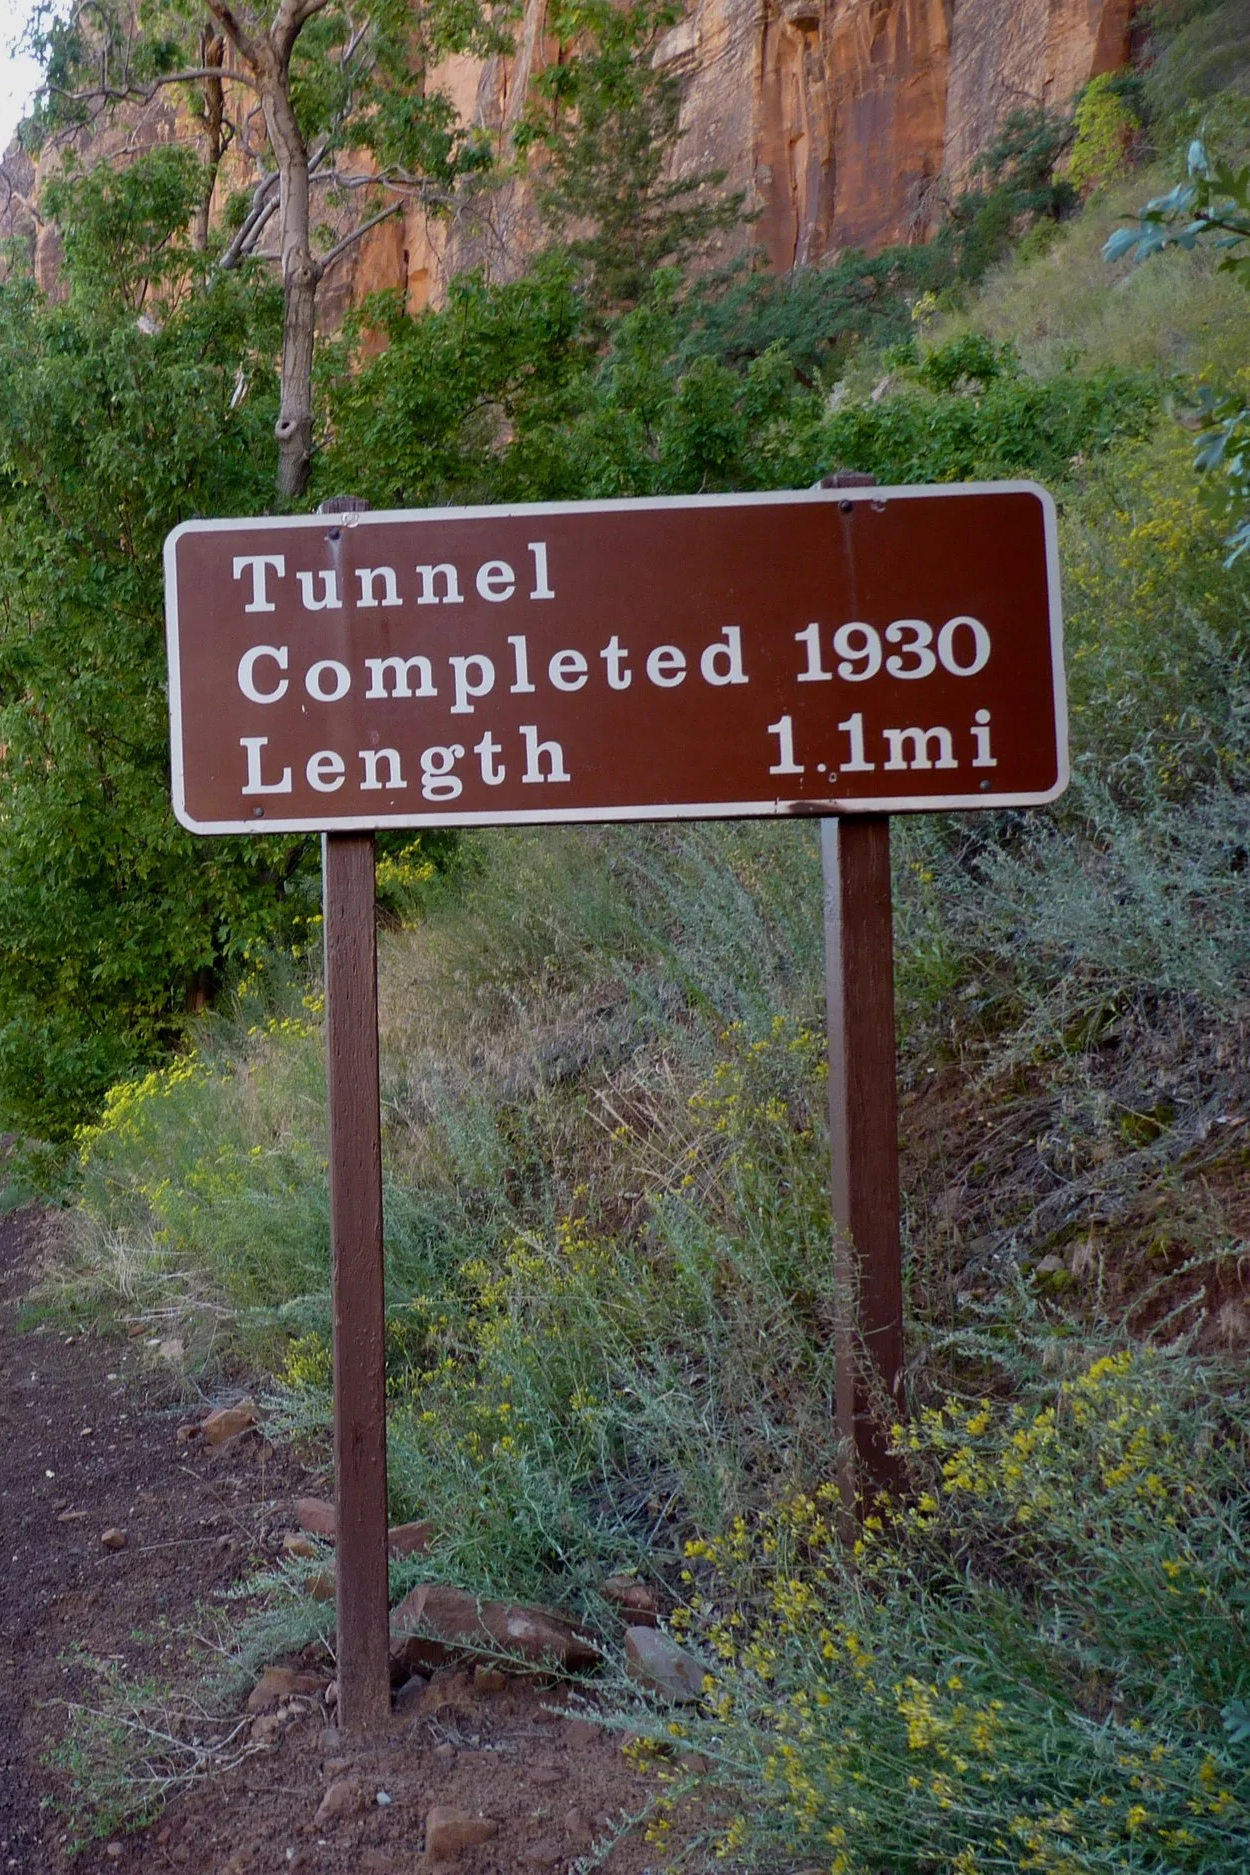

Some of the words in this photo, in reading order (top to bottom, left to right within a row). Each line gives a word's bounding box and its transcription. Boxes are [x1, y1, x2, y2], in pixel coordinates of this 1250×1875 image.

[232, 541, 555, 613] Tunnel
[237, 626, 750, 714] Completed
[794, 616, 991, 682] 1930
[239, 725, 571, 802] Length
